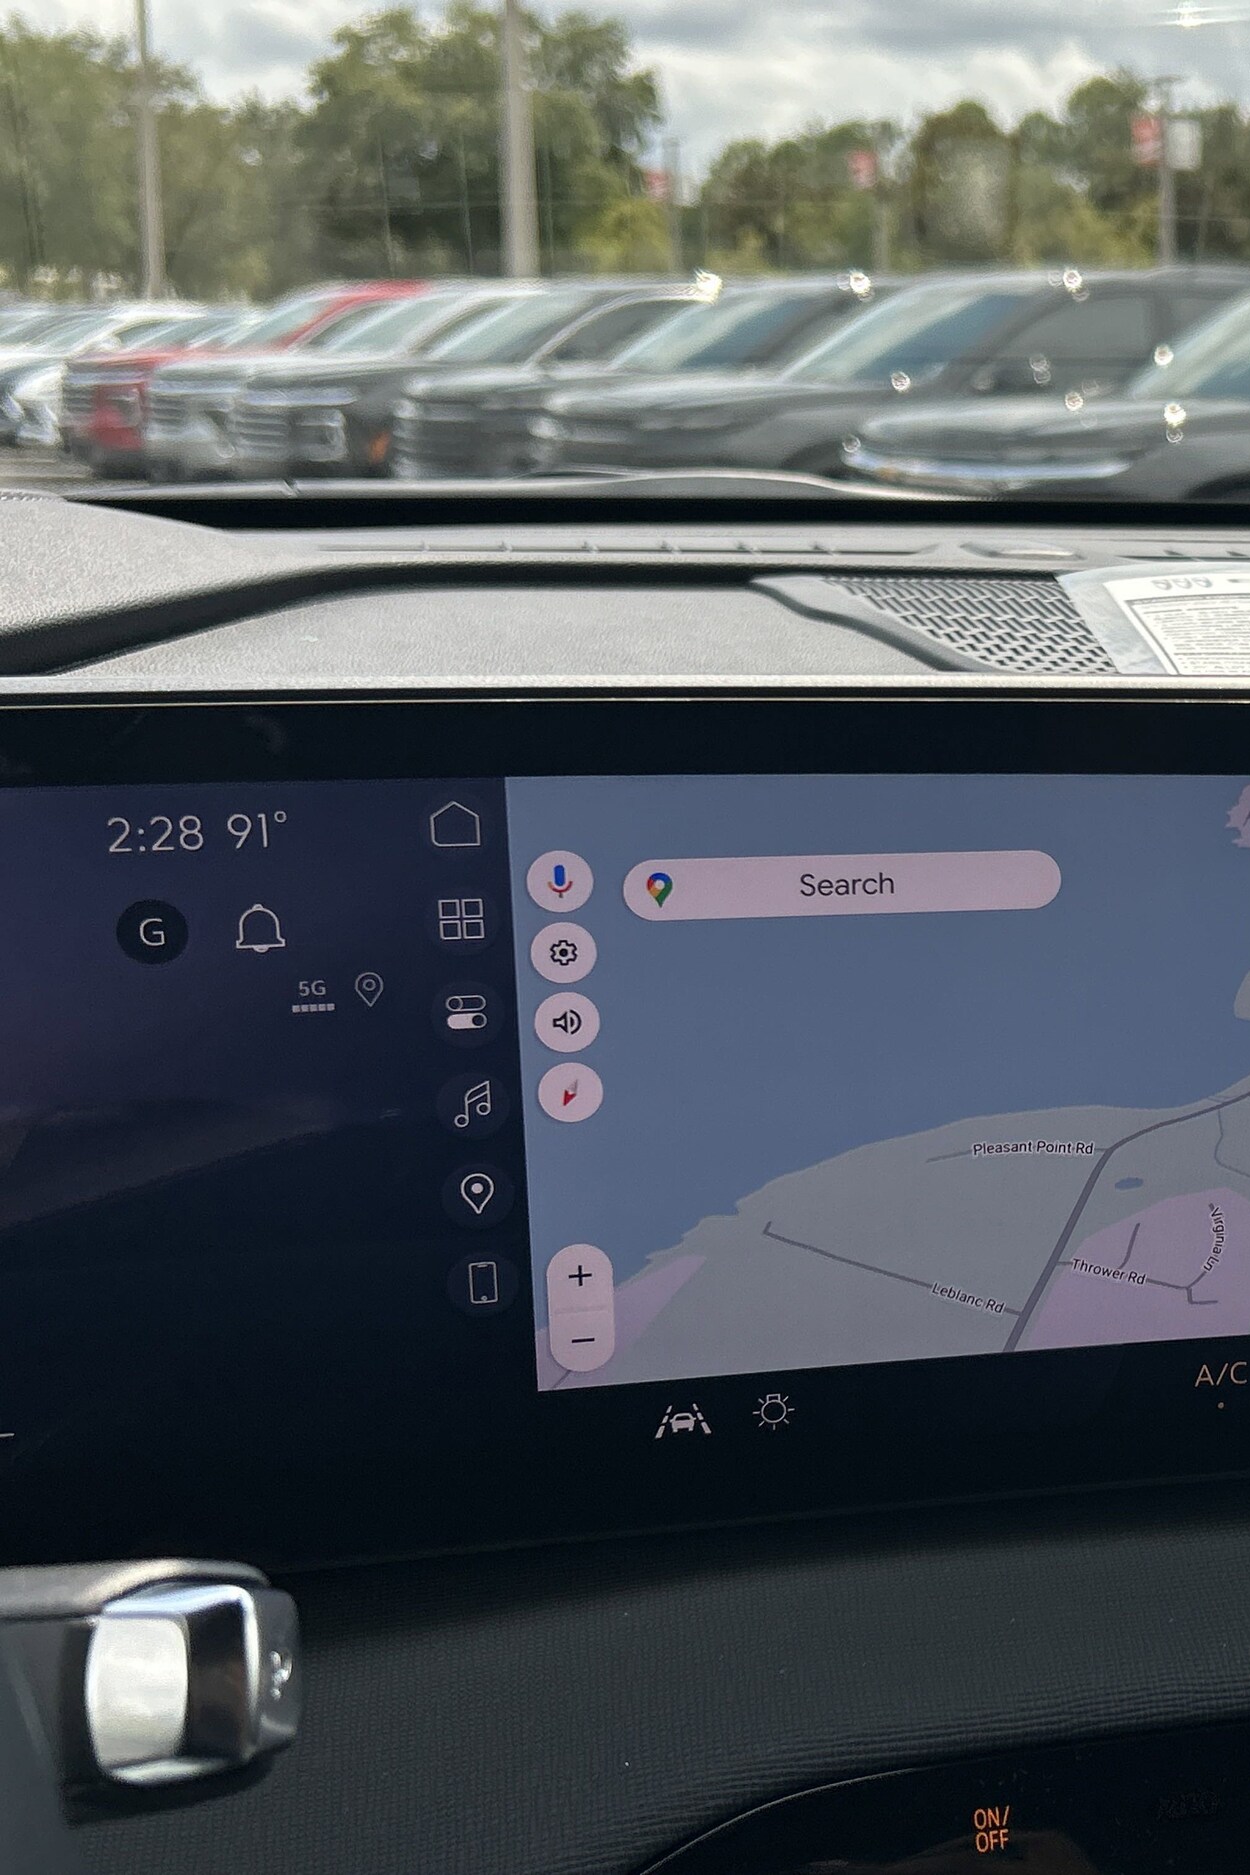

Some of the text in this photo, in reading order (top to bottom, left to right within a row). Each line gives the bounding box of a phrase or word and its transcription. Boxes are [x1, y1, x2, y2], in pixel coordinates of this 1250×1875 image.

[107, 815, 204, 852] 2:28
[799, 872, 895, 898] Search
[139, 917, 165, 947] G
[298, 980, 326, 996] 5G
[973, 1140, 1094, 1157] Pleasant Point Rd
[1204, 1207, 1225, 1273] Virginia Ln
[1071, 1258, 1146, 1285] Thrower Rd
[931, 1282, 1005, 1314] Leblanc Rd
[1194, 1361, 1247, 1387] A/C
[973, 1804, 1010, 1830] ON/
[975, 1829, 1009, 1853] OFF
